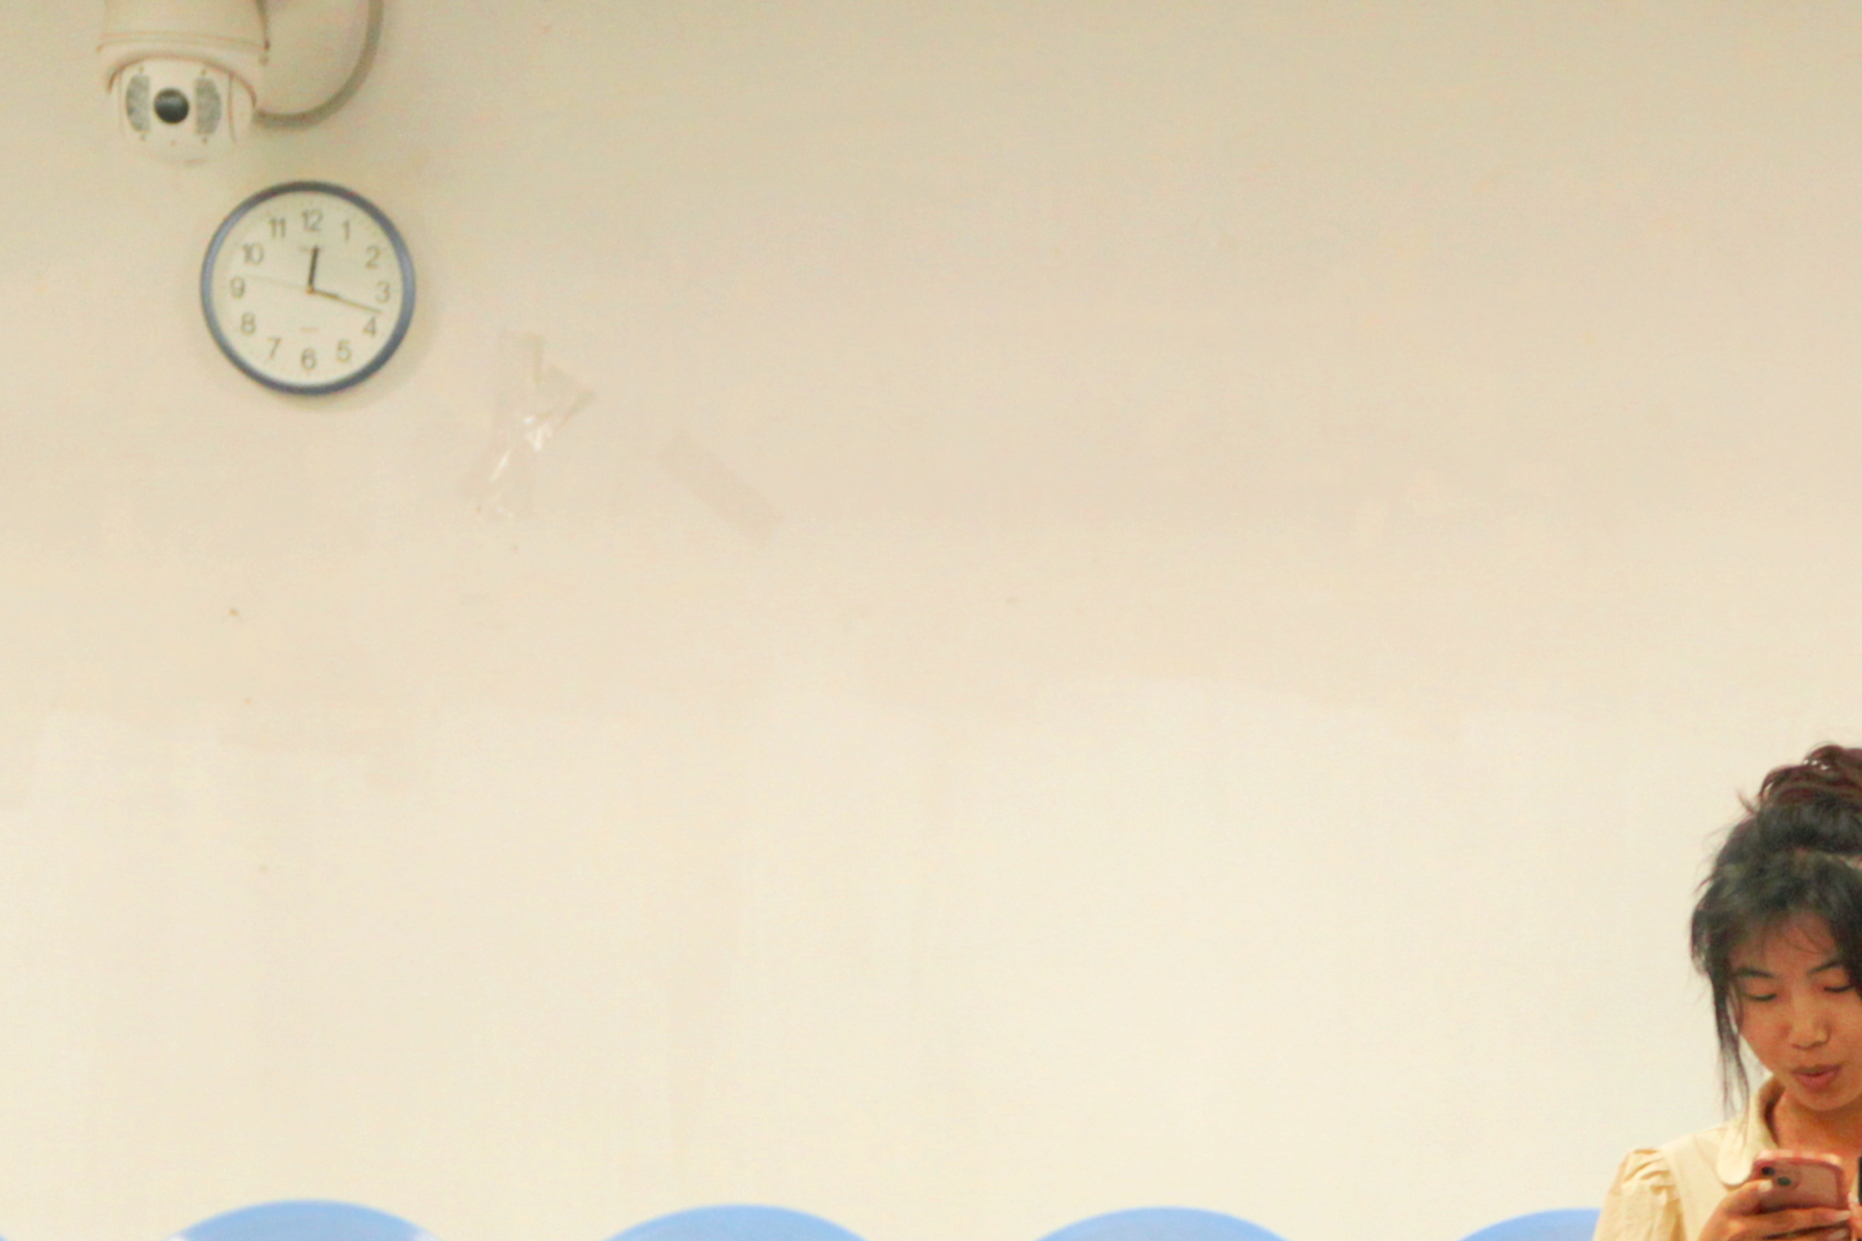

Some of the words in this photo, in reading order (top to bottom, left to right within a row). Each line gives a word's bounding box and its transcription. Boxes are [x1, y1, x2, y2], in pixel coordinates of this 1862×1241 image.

[269, 218, 286, 238] 11
[301, 209, 323, 231] 12
[342, 220, 351, 241] 1
[242, 243, 264, 264] 10
[365, 246, 381, 268] 2
[230, 277, 245, 298] 9
[376, 281, 390, 302] 3
[240, 313, 256, 335] 8
[363, 317, 377, 337] 4
[267, 337, 281, 359] 7
[336, 341, 351, 362] 5
[301, 348, 316, 370] 6
